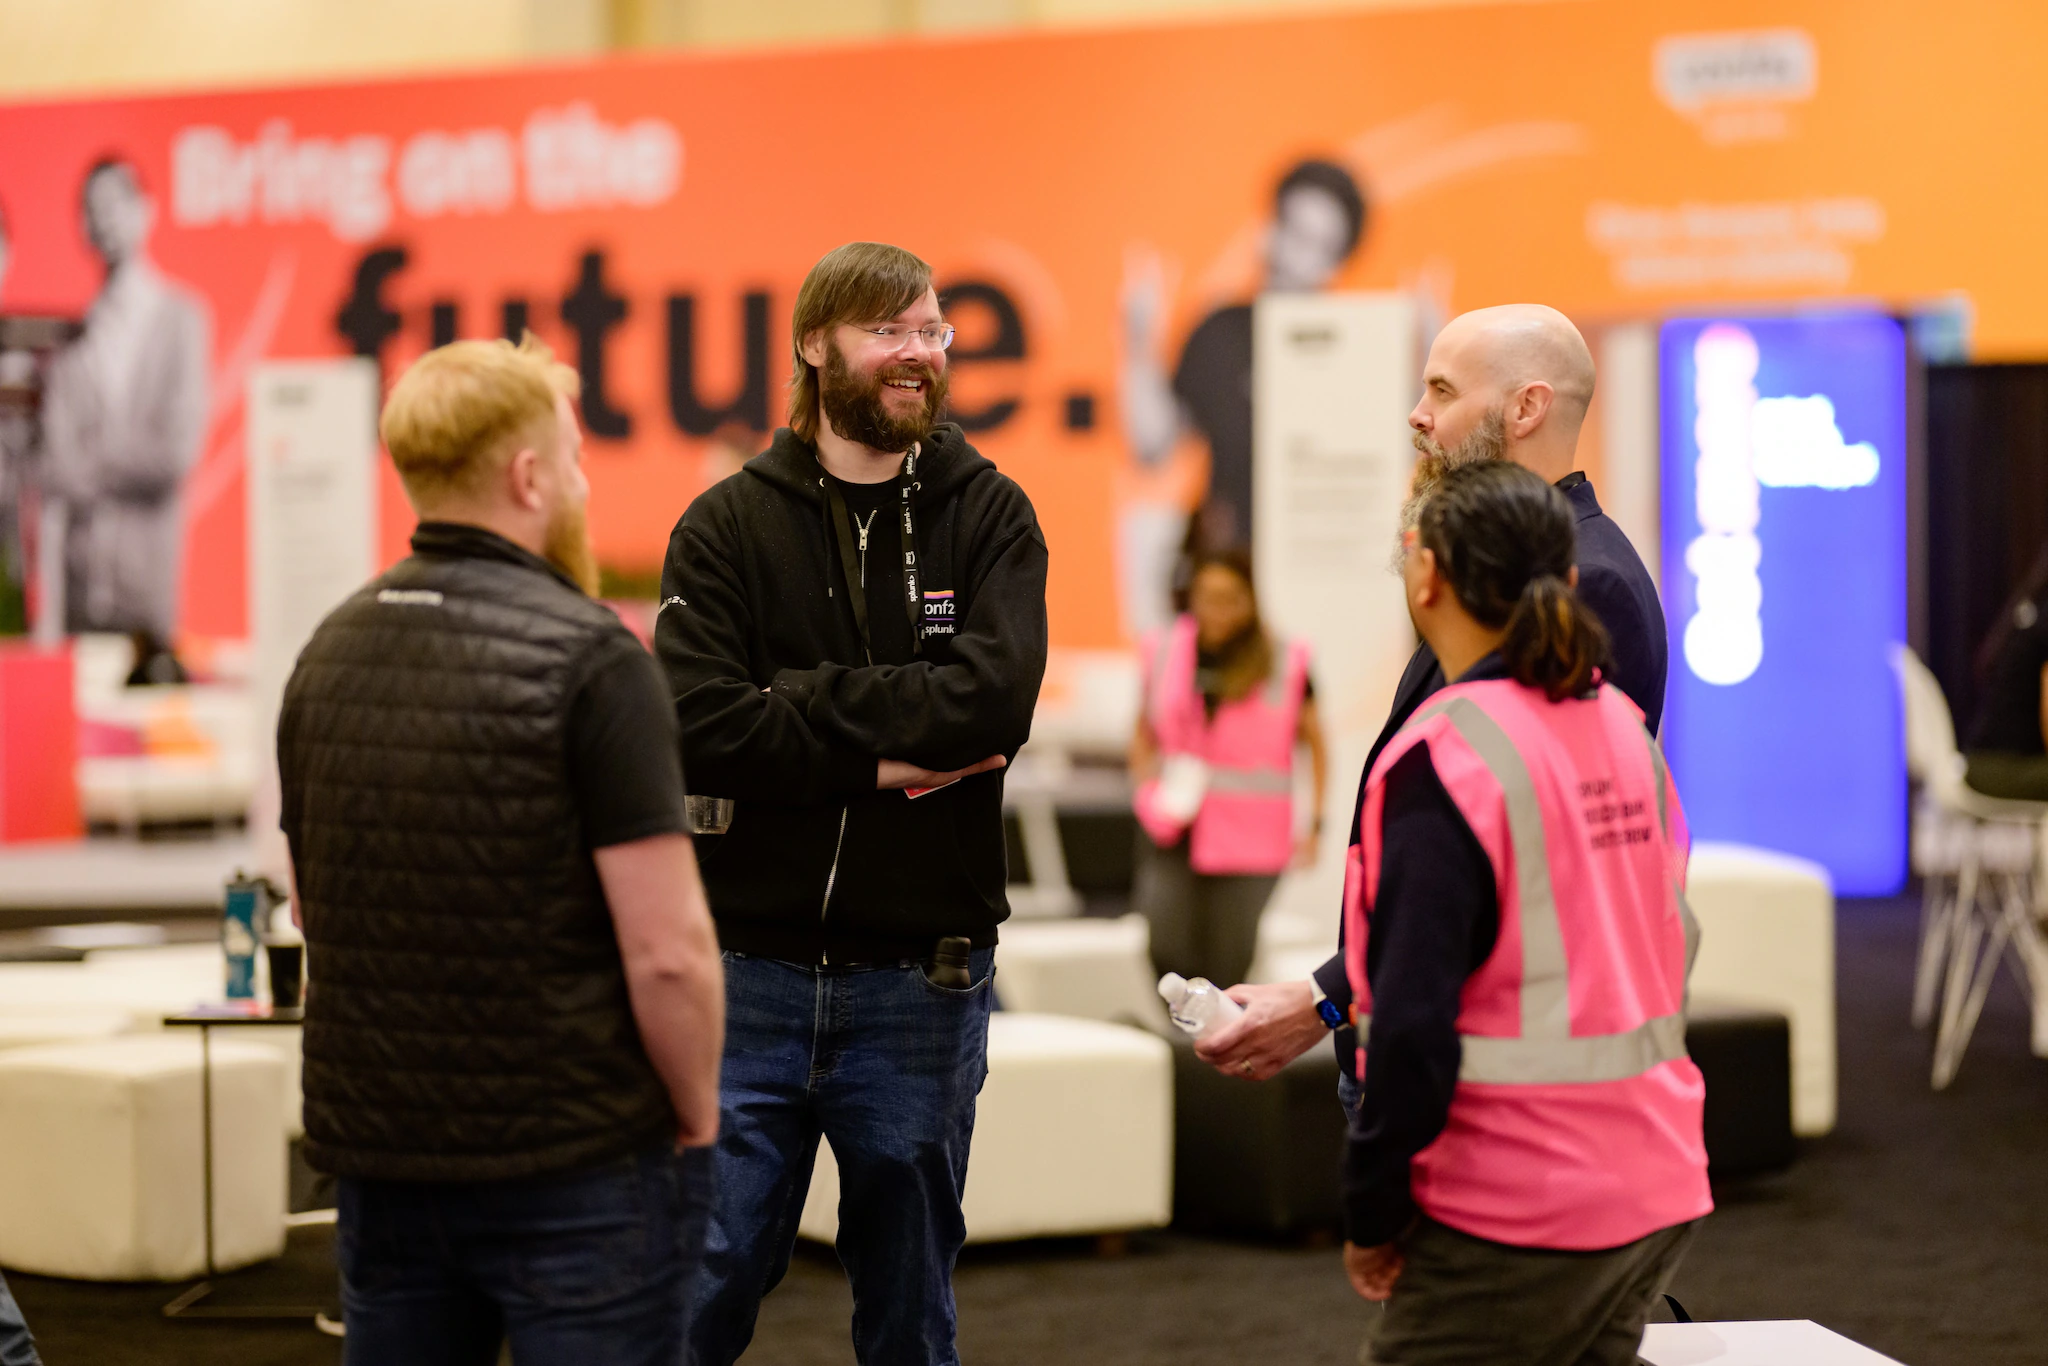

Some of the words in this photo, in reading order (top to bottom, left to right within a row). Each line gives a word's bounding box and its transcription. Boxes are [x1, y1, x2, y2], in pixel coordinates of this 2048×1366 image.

[172, 120, 392, 241] Bring
[401, 128, 516, 215] on
[524, 101, 683, 210] the
[338, 243, 1094, 437] ftue.
[908, 575, 918, 602] splunk>
[924, 600, 955, 615] onf2
[925, 624, 956, 636] splunk
